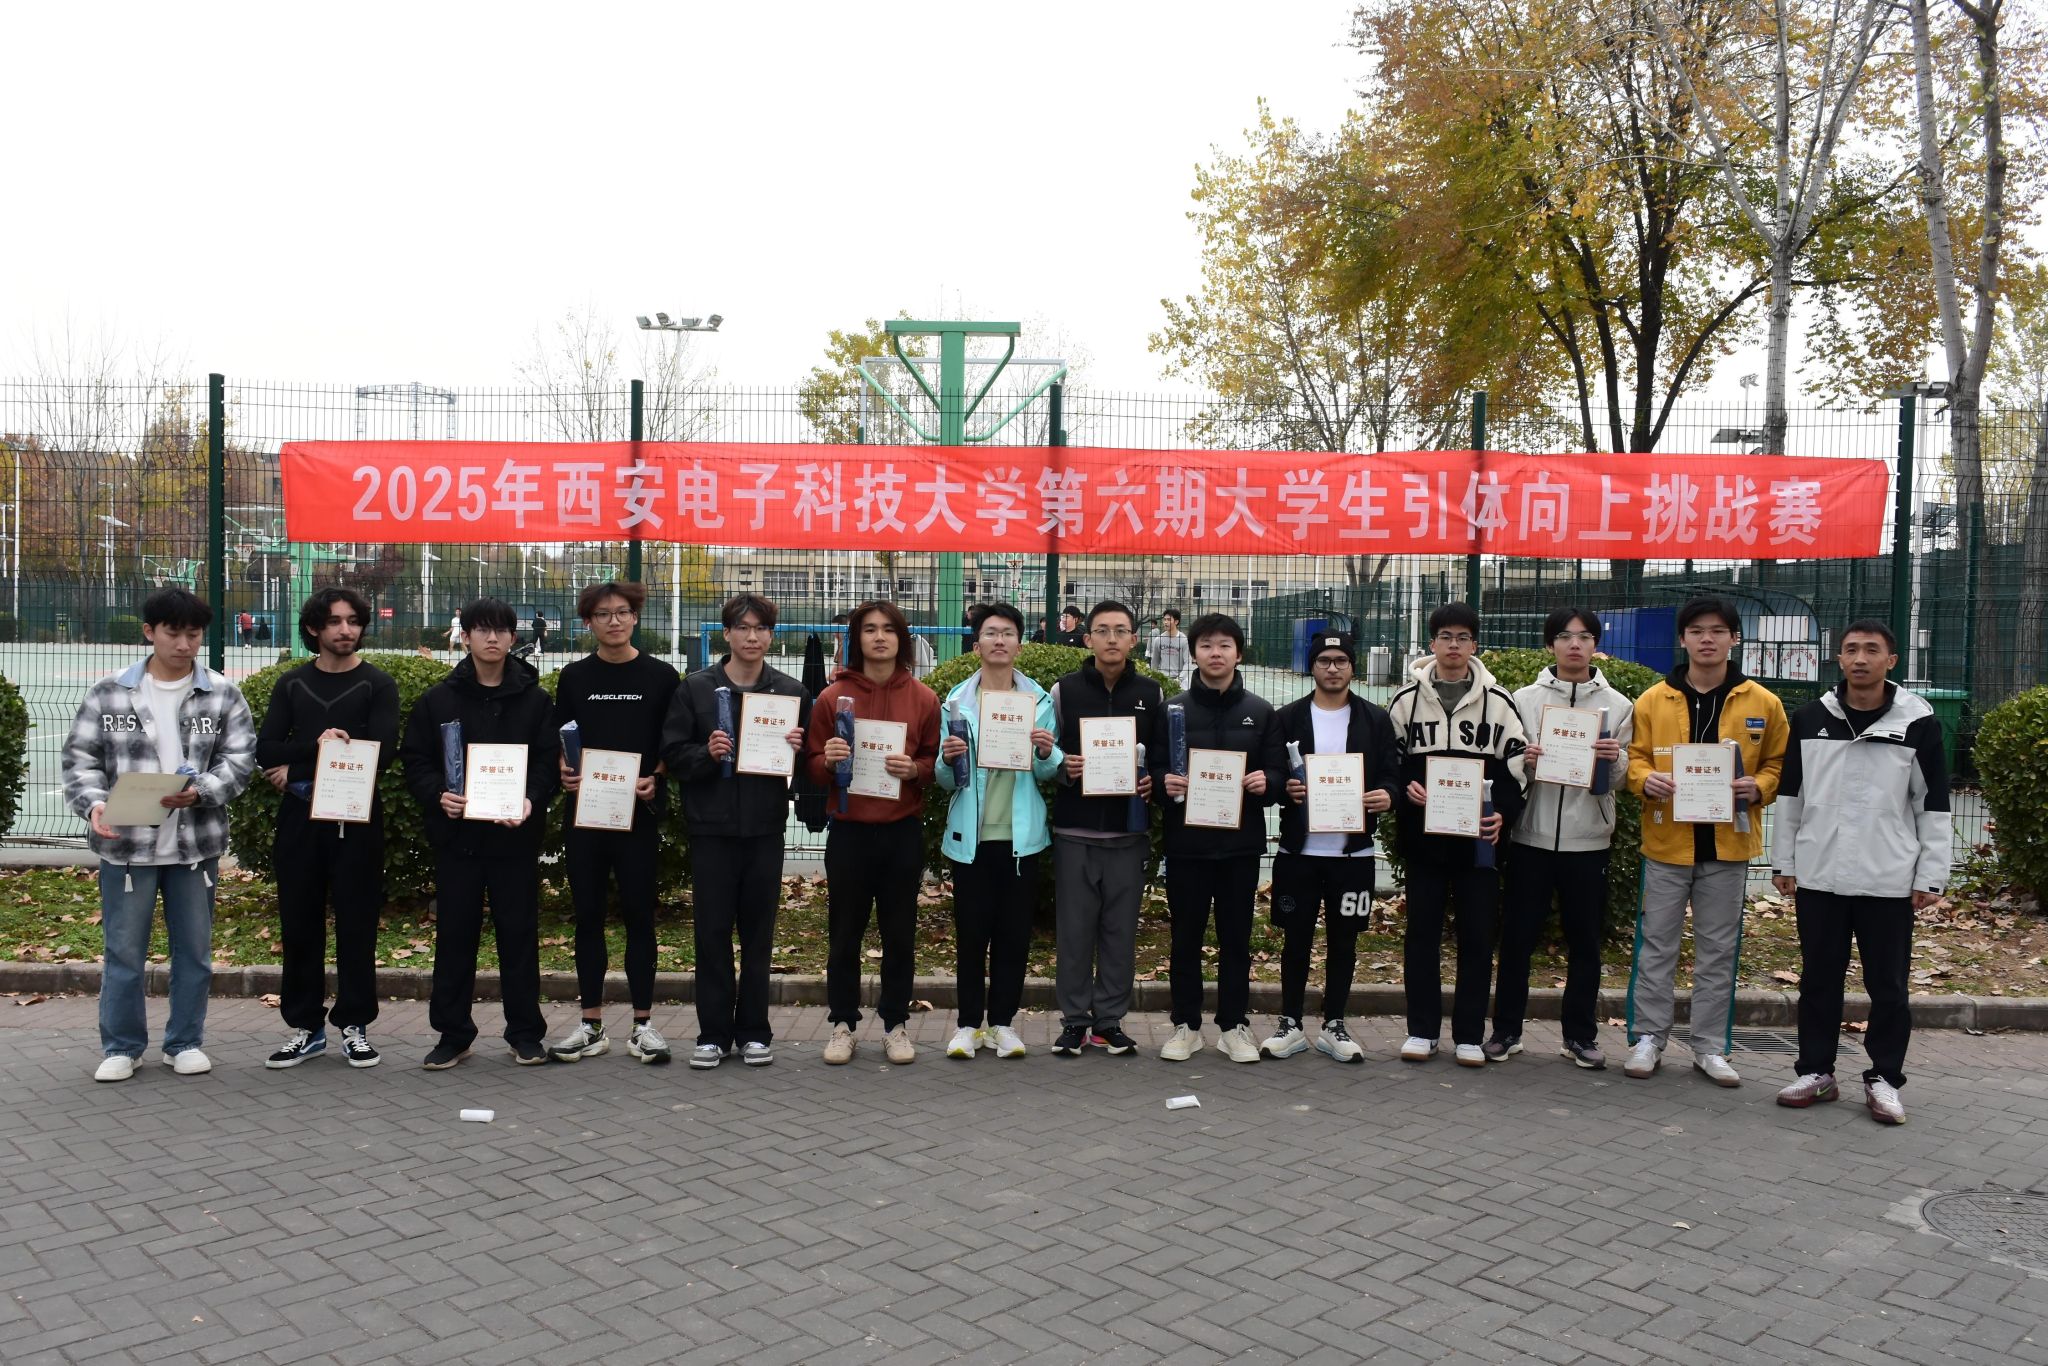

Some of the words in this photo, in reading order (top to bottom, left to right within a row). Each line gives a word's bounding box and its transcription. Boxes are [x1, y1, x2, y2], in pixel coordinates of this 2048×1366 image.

[352, 457, 1822, 546] 2025年西安电子科技大学第六期大学生引体向上挑战赛
[102, 714, 147, 732] RES
[1340, 891, 1370, 917] 60
